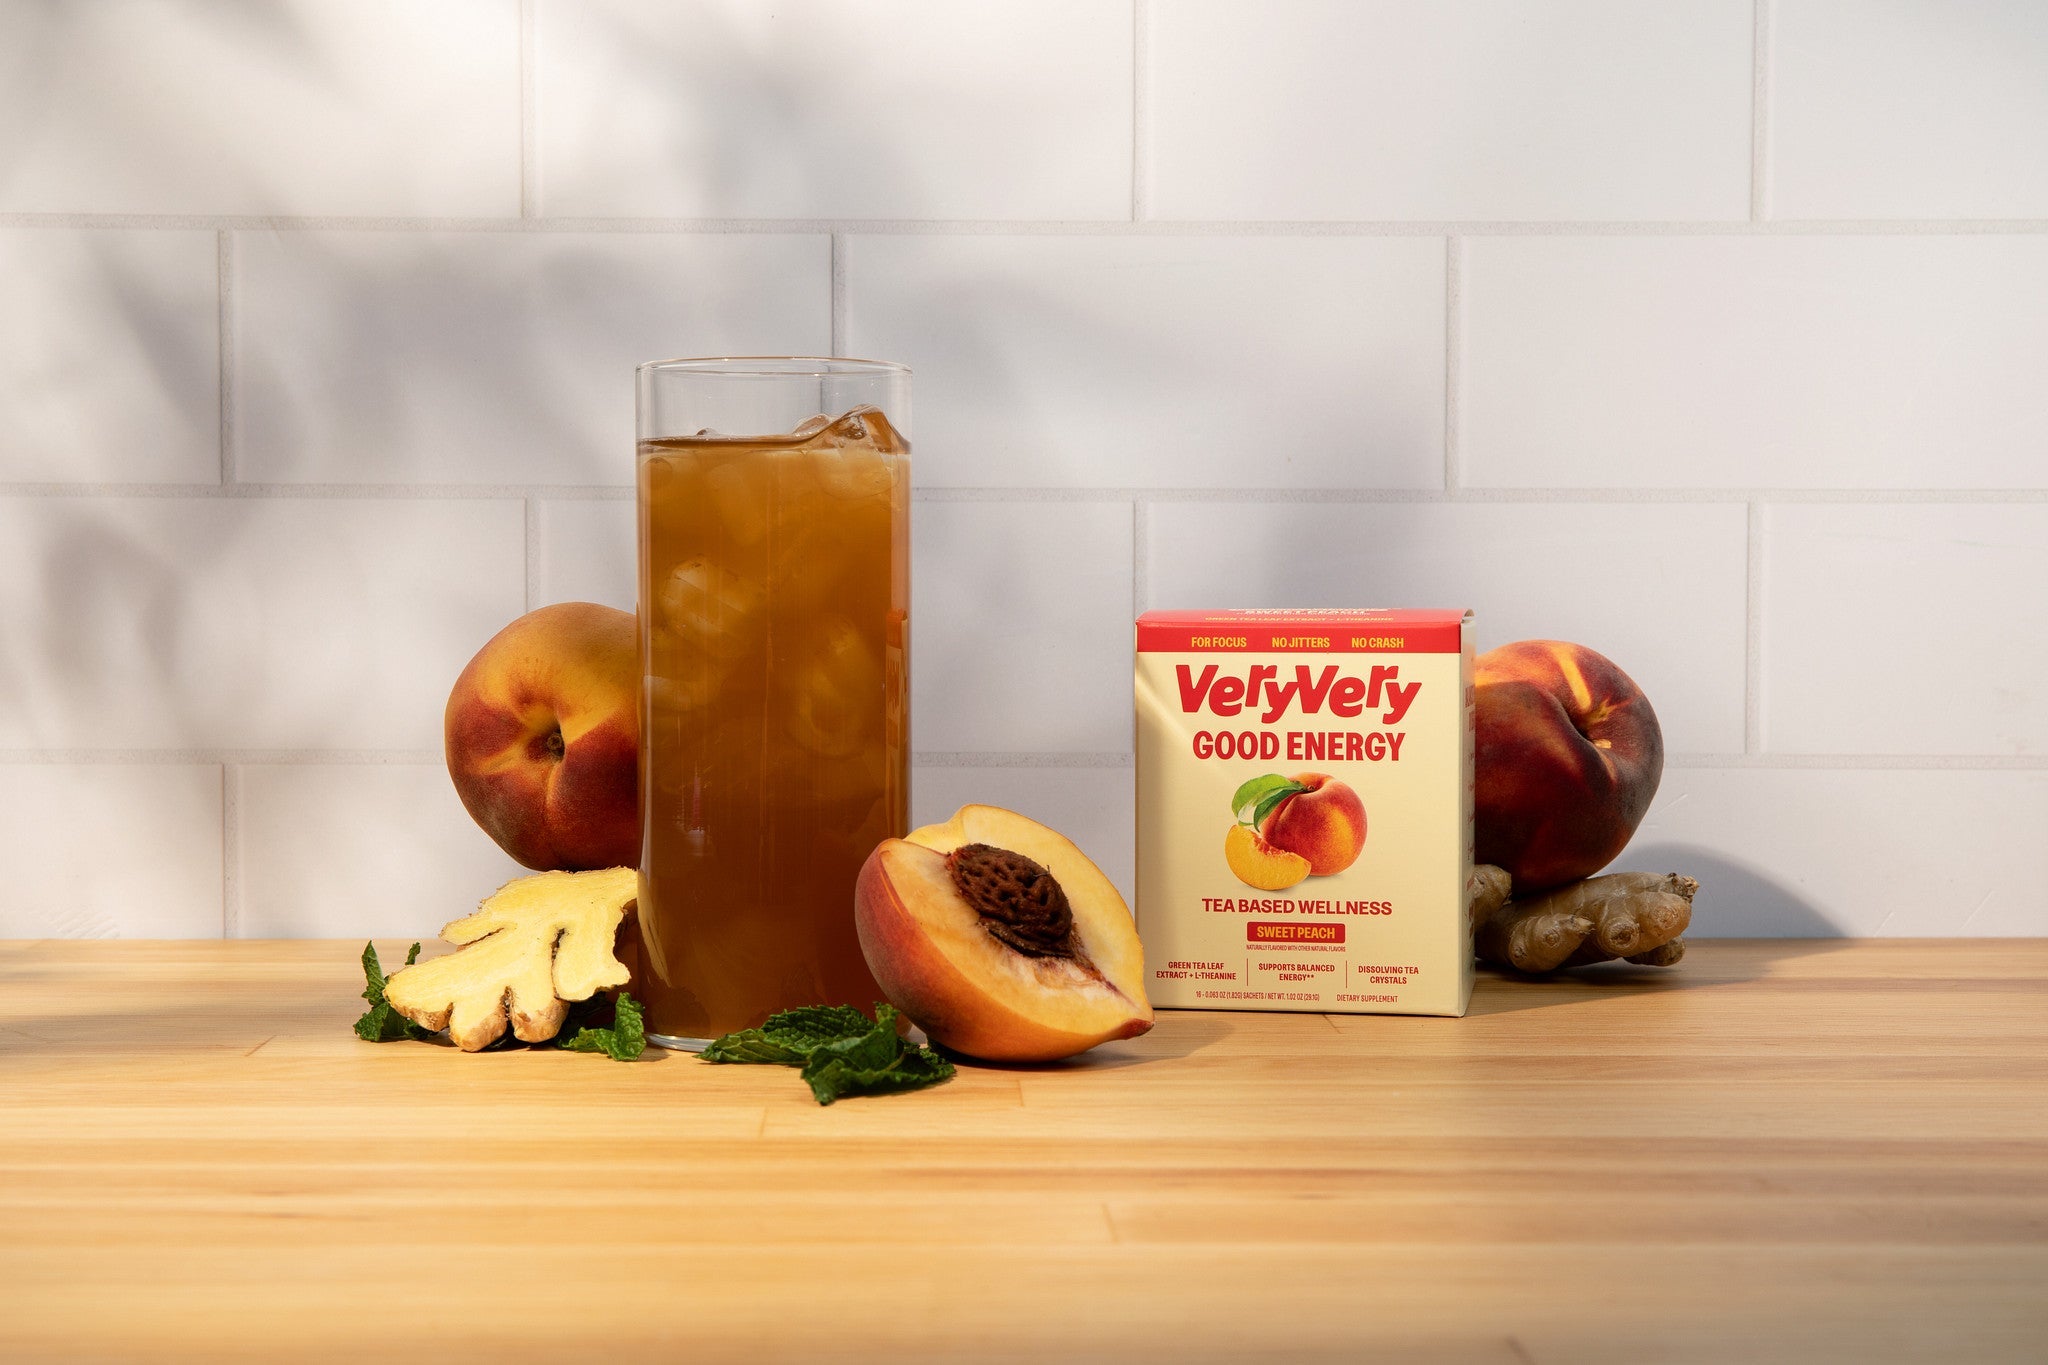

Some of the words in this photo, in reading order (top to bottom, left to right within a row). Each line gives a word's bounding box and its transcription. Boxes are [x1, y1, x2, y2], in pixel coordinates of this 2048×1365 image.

[1191, 637, 1210, 648] FOR
[1212, 637, 1246, 648] FOCUS
[1272, 637, 1287, 648] NO
[1288, 637, 1330, 648] JITTERS
[1352, 637, 1367, 648] NO
[1369, 637, 1404, 648] CRASH
[1176, 664, 1422, 724] VeryVery
[1192, 730, 1280, 760] GOOD
[1287, 732, 1406, 761] ENERGY
[1202, 898, 1235, 912] TEA
[1238, 899, 1295, 914] BASED
[1298, 900, 1392, 916] WELLNESS
[1257, 925, 1296, 938] SWEET
[1298, 926, 1335, 939] PEACH
[1258, 963, 1295, 971] SUPPORTS
[1358, 966, 1403, 974] DISSOLVING
[1156, 971, 1187, 979] EXTRACT
[1195, 972, 1236, 980] L-THEANINE
[1370, 976, 1407, 984] CRYSTALS
